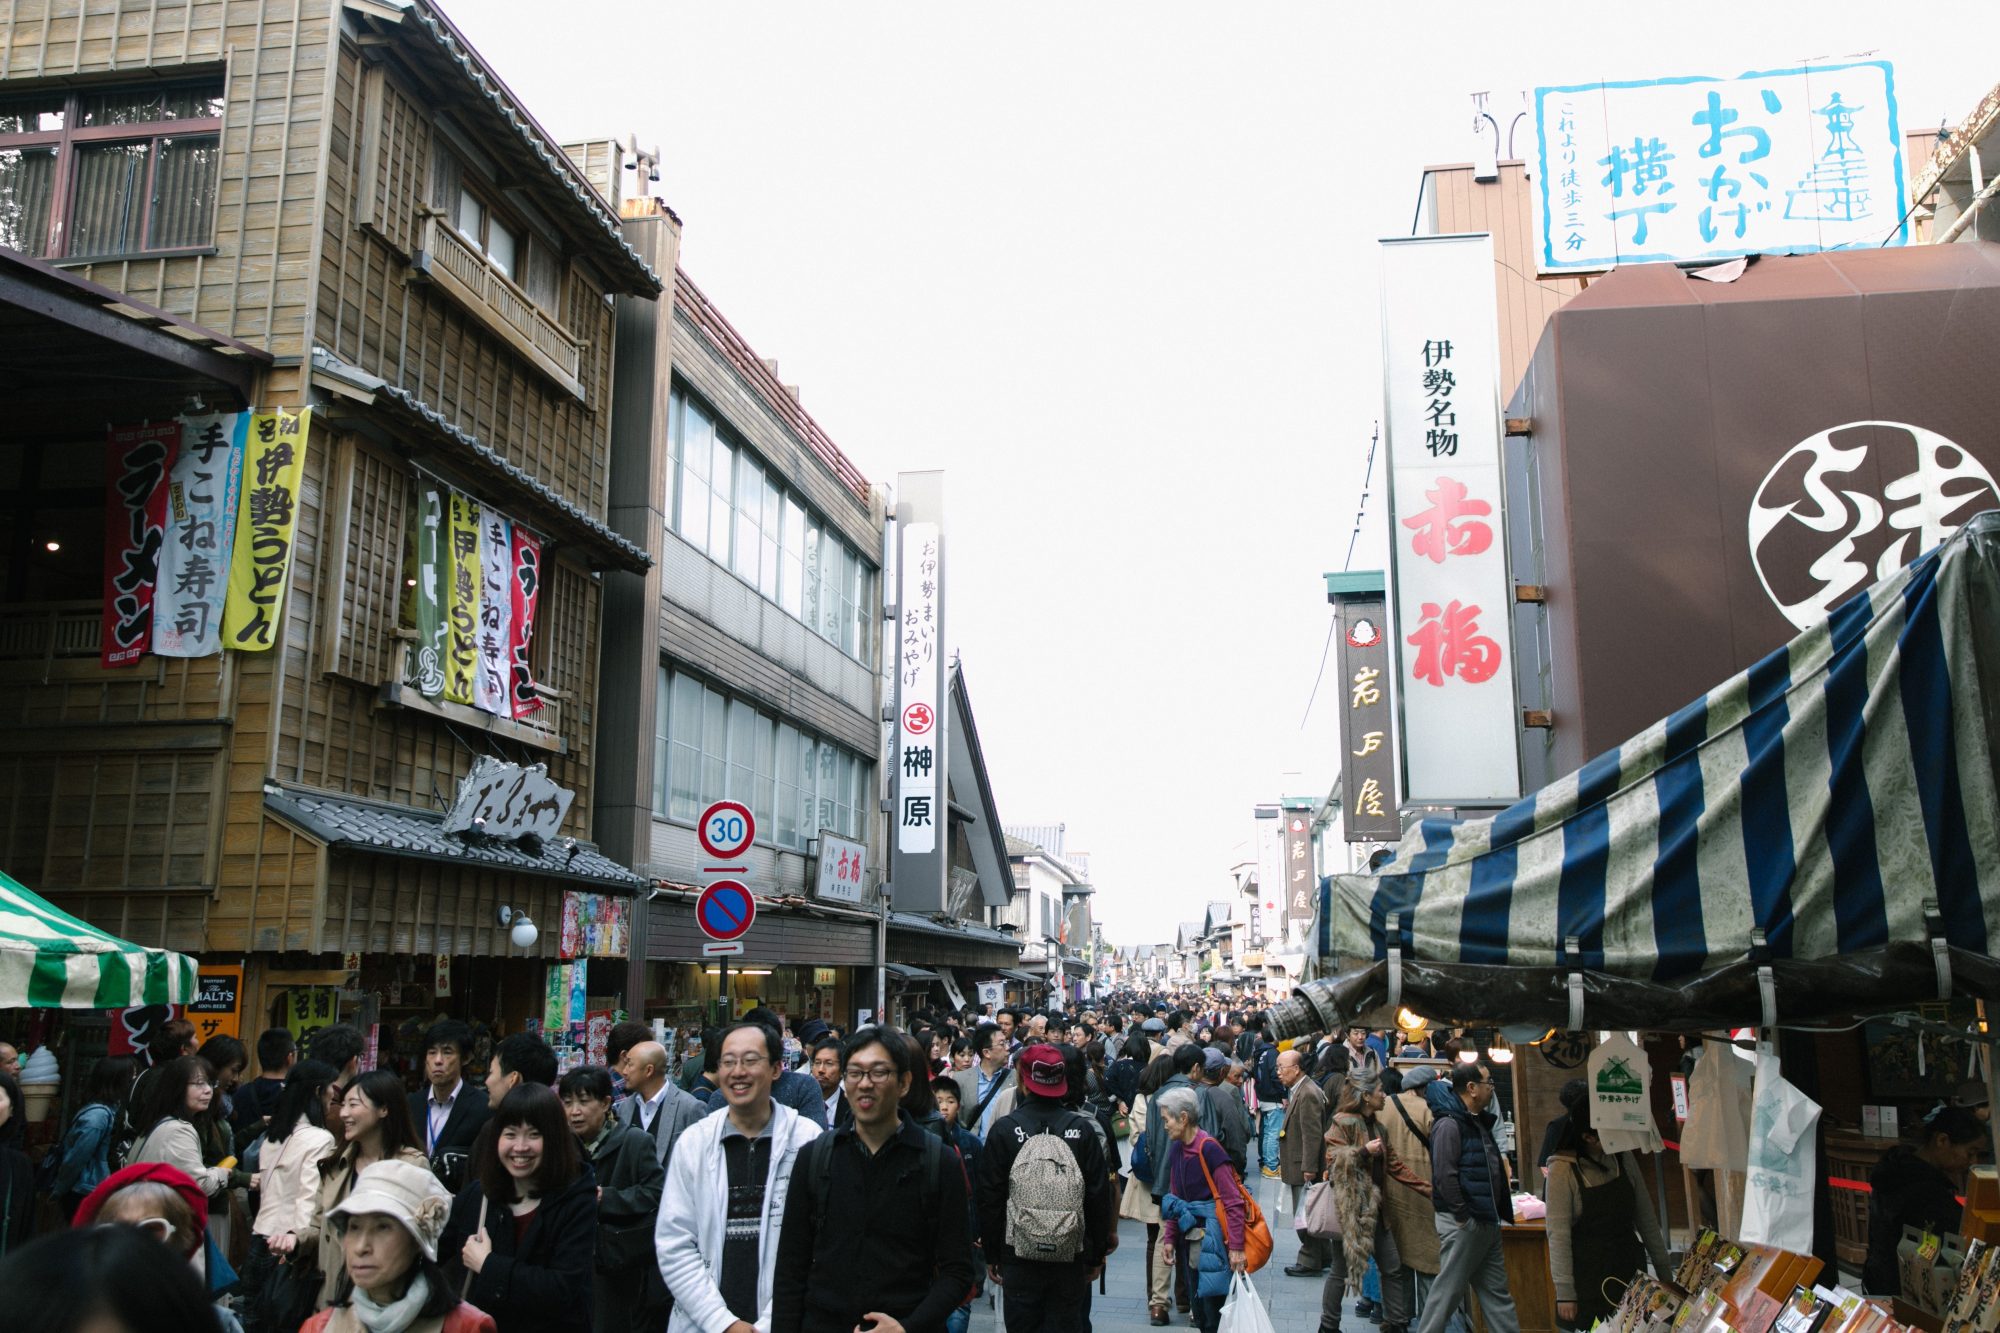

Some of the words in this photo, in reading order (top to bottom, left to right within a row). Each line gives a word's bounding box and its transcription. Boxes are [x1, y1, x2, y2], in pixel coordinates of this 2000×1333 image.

[1558, 102, 1587, 251] これより徒歩三分
[1598, 137, 1677, 245] 横丁
[1692, 90, 1781, 243] おかげ
[1421, 339, 1458, 457] 伊勢名物
[172, 422, 230, 644] 手こね寿司
[236, 442, 295, 645] 伊勢うどん
[1402, 476, 1502, 687] 赤福
[451, 525, 478, 700] 伊勢うどん
[480, 522, 507, 704] 手こね寿司
[903, 608, 921, 689] おみやげ
[920, 539, 937, 664] お伊勢まいり
[903, 745, 933, 827] 榊原
[1352, 665, 1386, 817] 岩戸屋
[711, 817, 743, 843] 30
[837, 846, 861, 884] 赤福
[1291, 840, 1307, 909] 岩戸屋
[438, 954, 449, 990] 赤福
